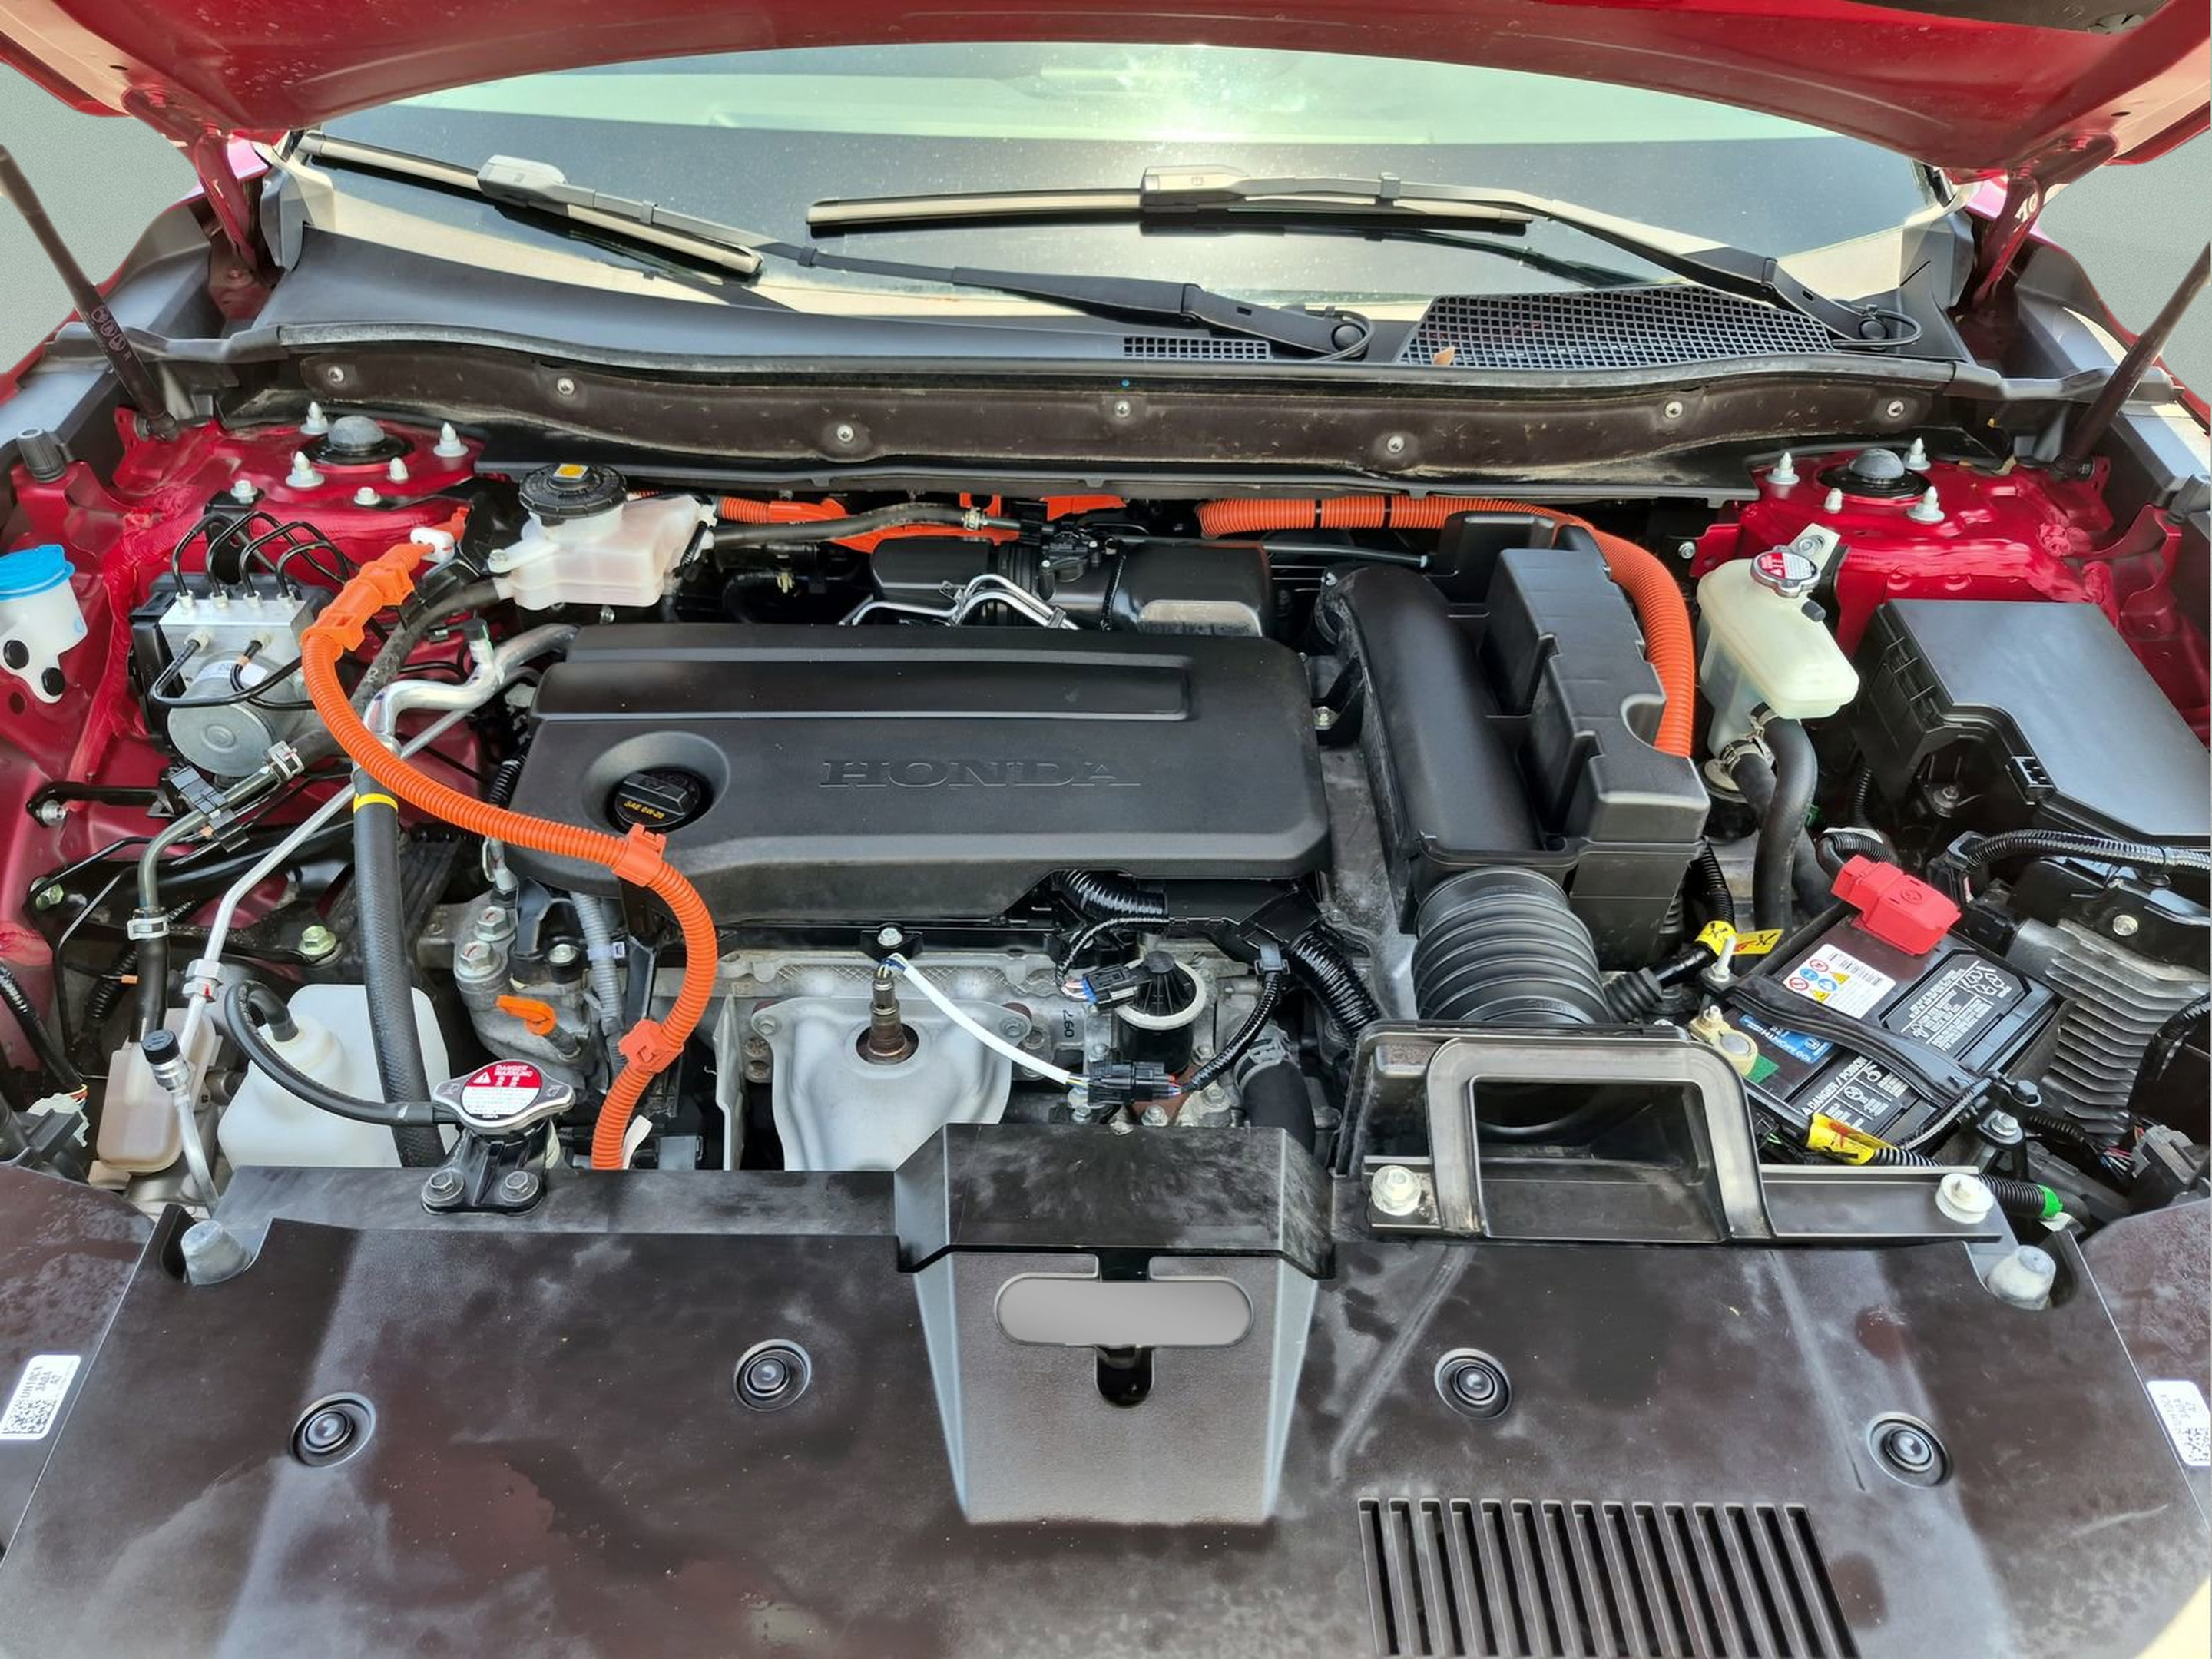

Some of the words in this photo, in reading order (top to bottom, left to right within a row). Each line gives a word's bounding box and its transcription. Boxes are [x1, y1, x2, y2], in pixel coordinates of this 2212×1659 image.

[819, 762, 1141, 788] HONDA
[624, 801, 641, 810] SAE
[1062, 1009, 1075, 1038] 097
[1807, 1081, 1839, 1110] DANGER
[1839, 1056, 1868, 1081] POISON
